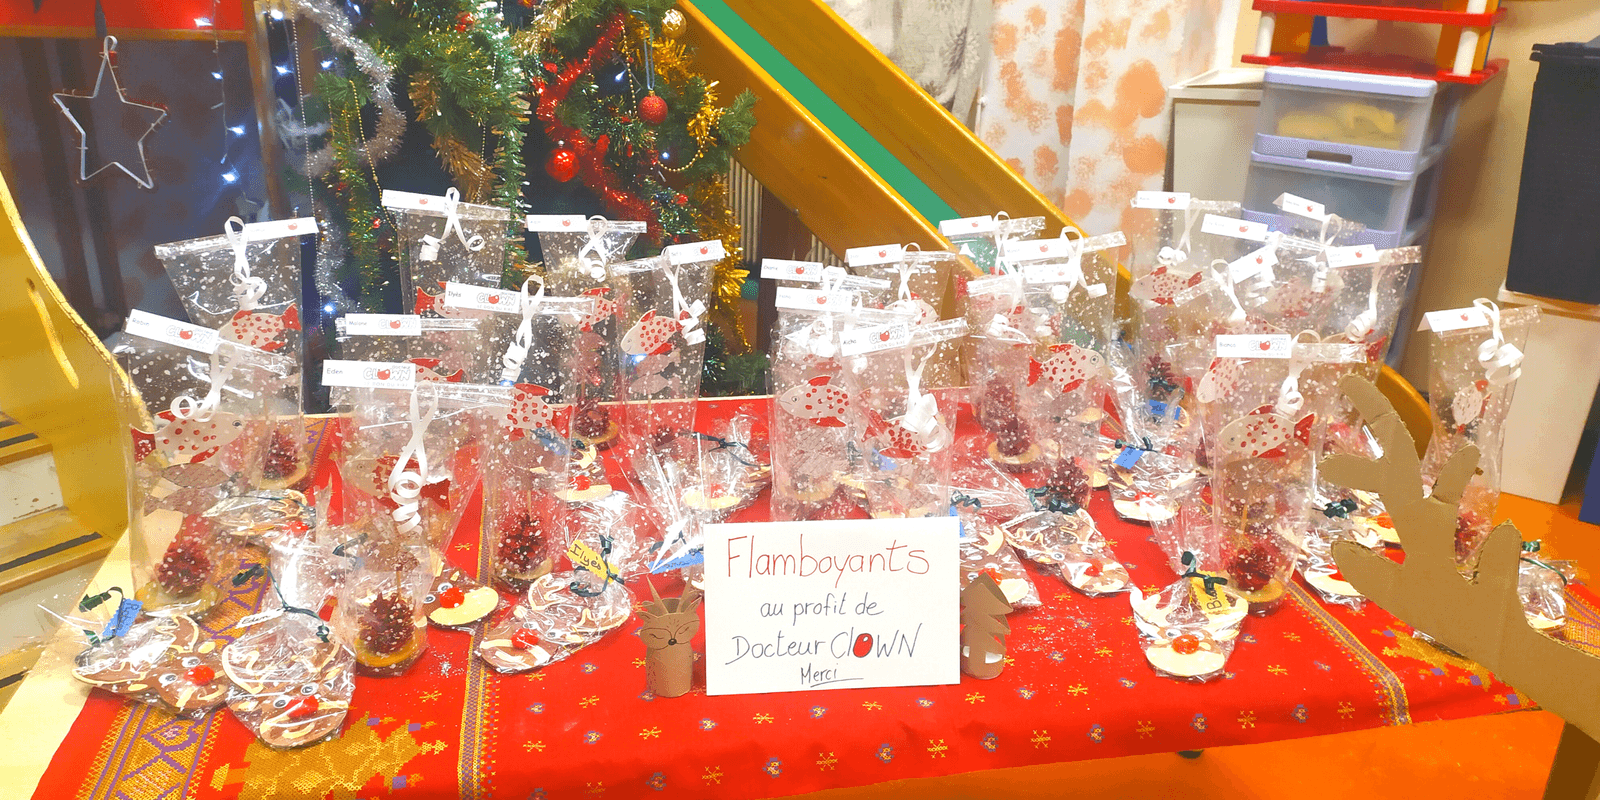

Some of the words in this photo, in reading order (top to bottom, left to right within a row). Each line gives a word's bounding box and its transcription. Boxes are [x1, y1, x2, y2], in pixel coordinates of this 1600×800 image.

[728, 534, 930, 588] Flamboyants
[760, 603, 783, 617] au
[793, 592, 846, 626] profit
[855, 592, 884, 615] de
[725, 630, 826, 665] Docteur
[800, 663, 838, 685] Merci
